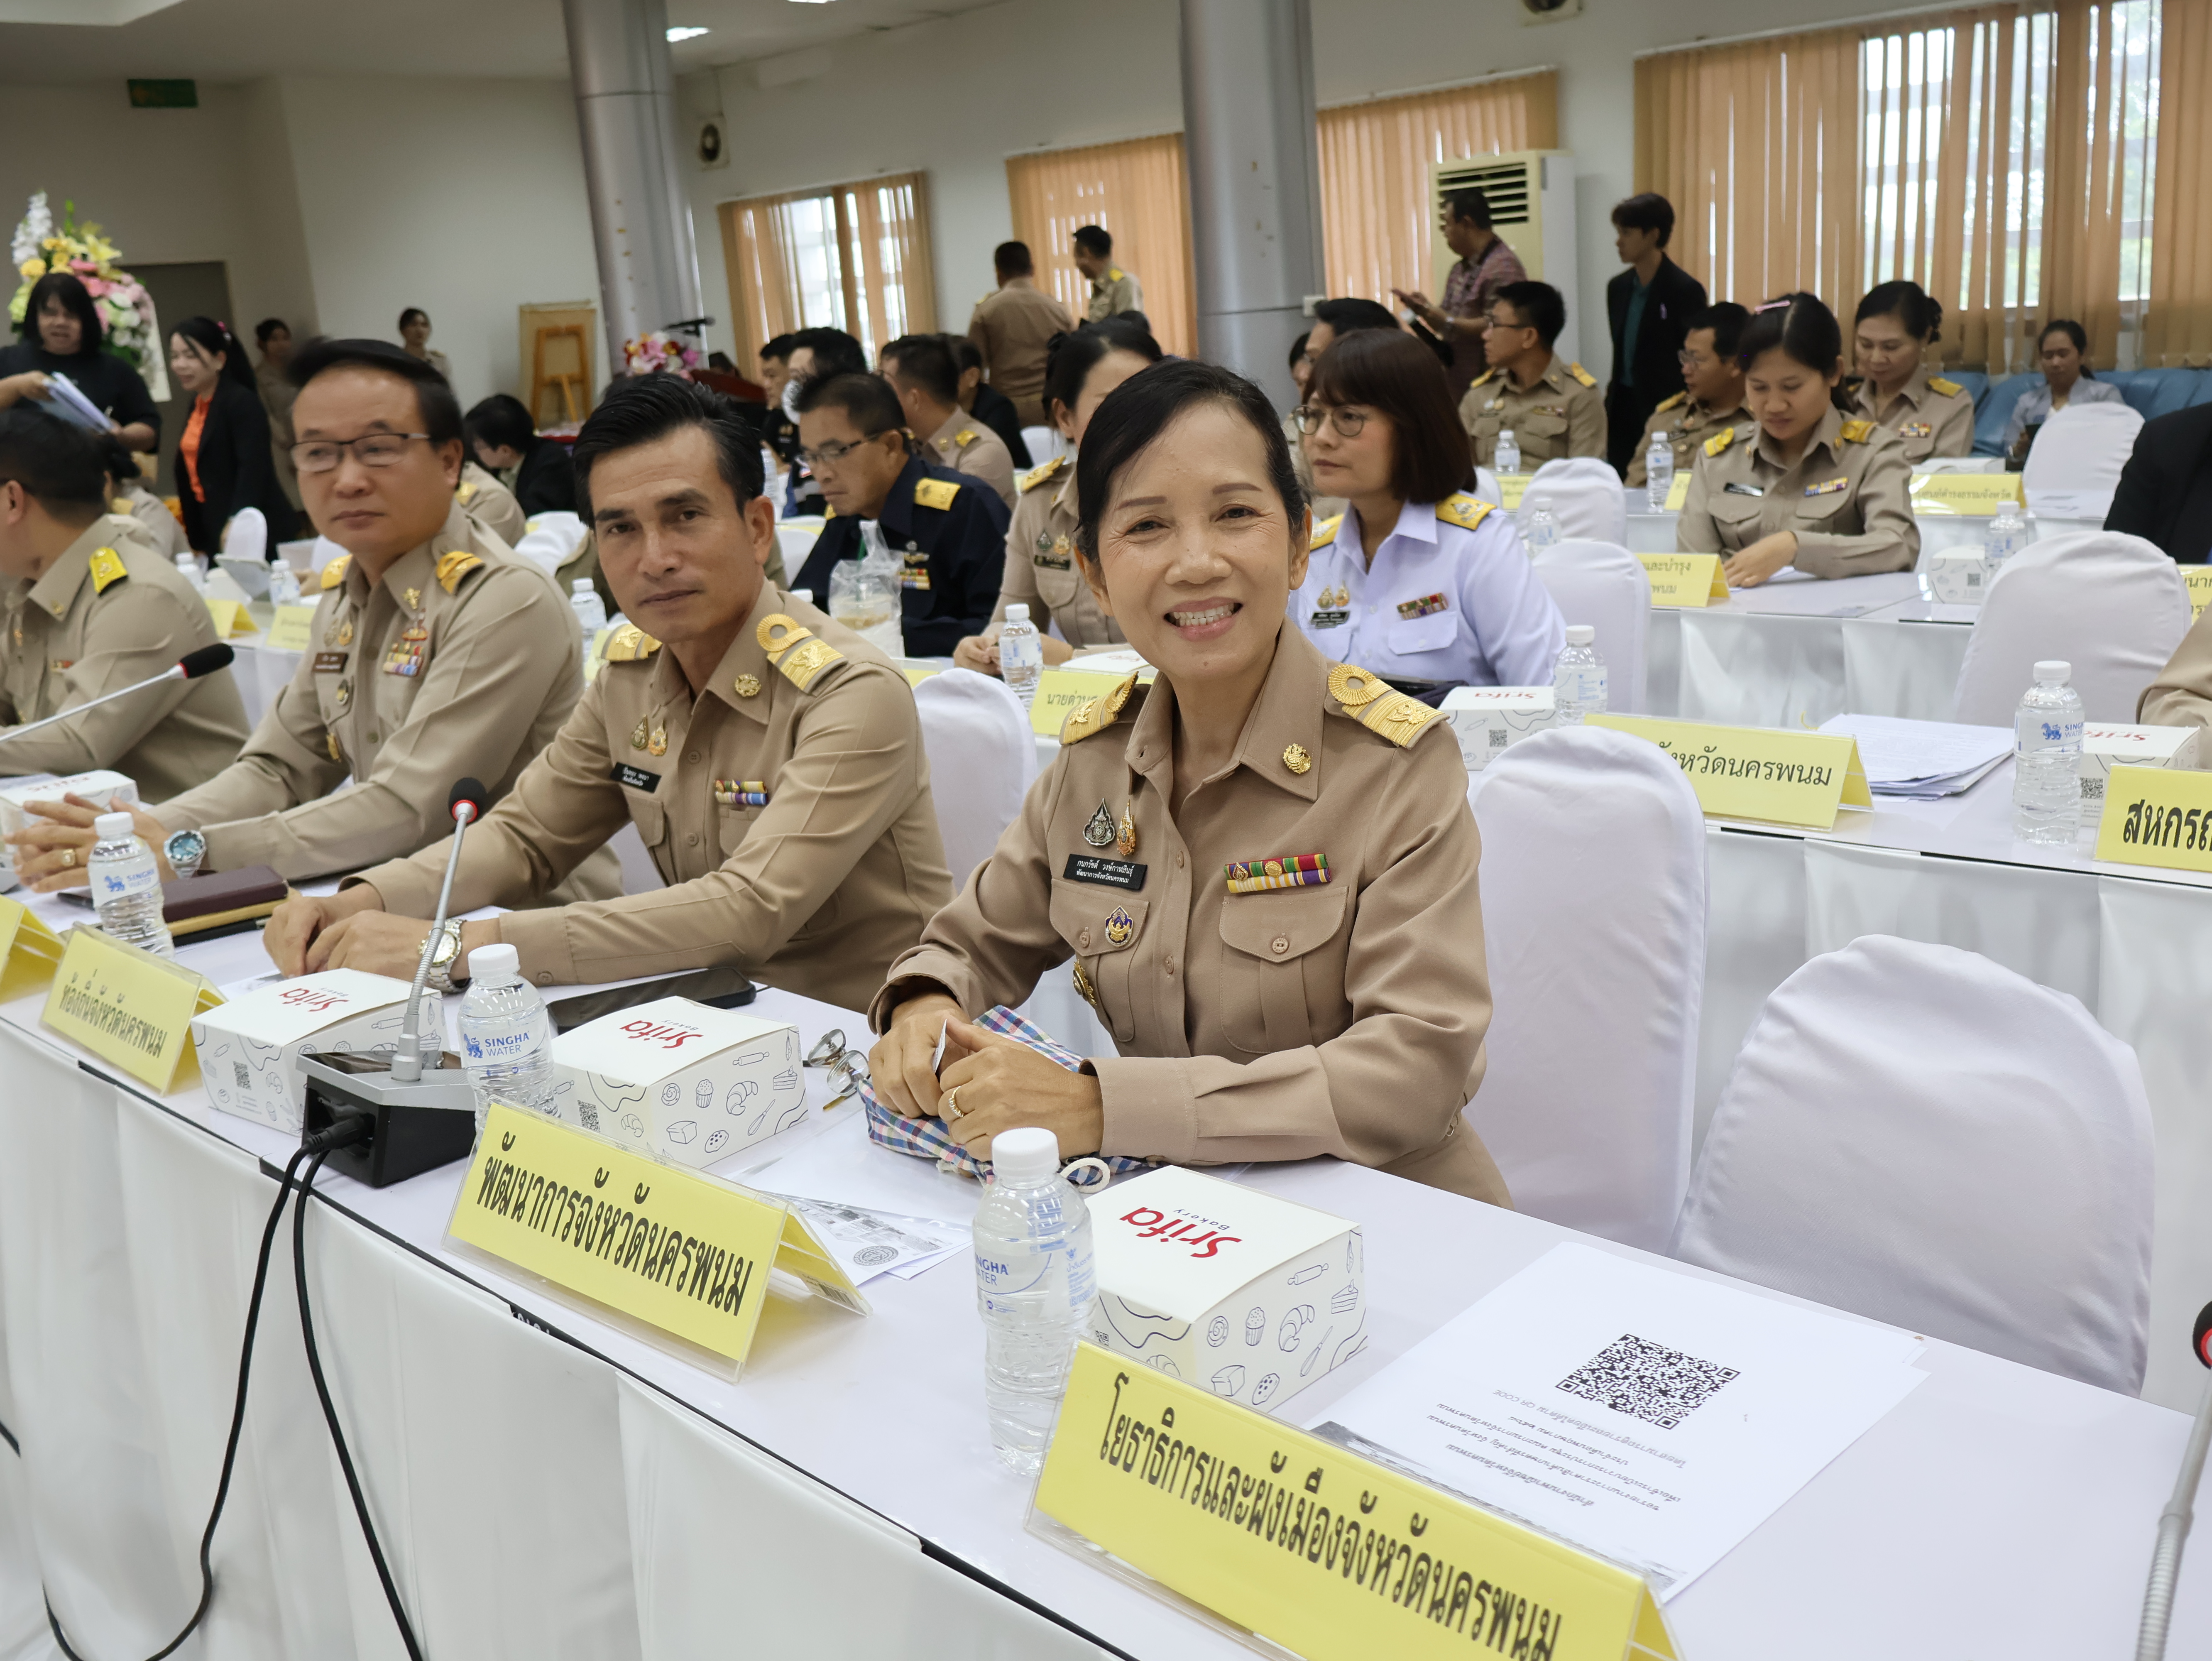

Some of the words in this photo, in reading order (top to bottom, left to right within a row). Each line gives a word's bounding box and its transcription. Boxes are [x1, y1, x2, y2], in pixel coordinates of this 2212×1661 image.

[1076, 869, 1129, 883] พัฒนาการจังหวัดนครพนม
[1077, 859, 1100, 869] กนกรัชต์
[278, 988, 350, 1012] Srifa
[59, 968, 167, 1059] ท้องถิ่นจังหวัดนครพนม
[661, 1019, 699, 1031] Bakery
[484, 1032, 530, 1047] SINGHA
[619, 1020, 704, 1049] Srifa
[486, 1044, 521, 1056] WATER
[476, 1130, 754, 1317] พัฒนาการจังหวัดนครพนม
[1118, 1207, 1243, 1258] Srifa
[1172, 1209, 1231, 1230] Bakery
[1492, 1389, 1520, 1402] CODE
[1520, 1399, 1535, 1408] QR
[1426, 1414, 1488, 1443] จังหวัดนครพนม
[1536, 1406, 1686, 1469] โดยสามารถดูรายละเอียดได้ตาม
[1536, 1427, 1629, 1466] ประจำเดือนพฤษภาคม
[1548, 1447, 1681, 1502] เพื่อเข้าระเบียบวาระการประชุม
[1099, 1372, 1563, 1661] โยธาธิการและผังเมืองจังหวัดนครพนม
